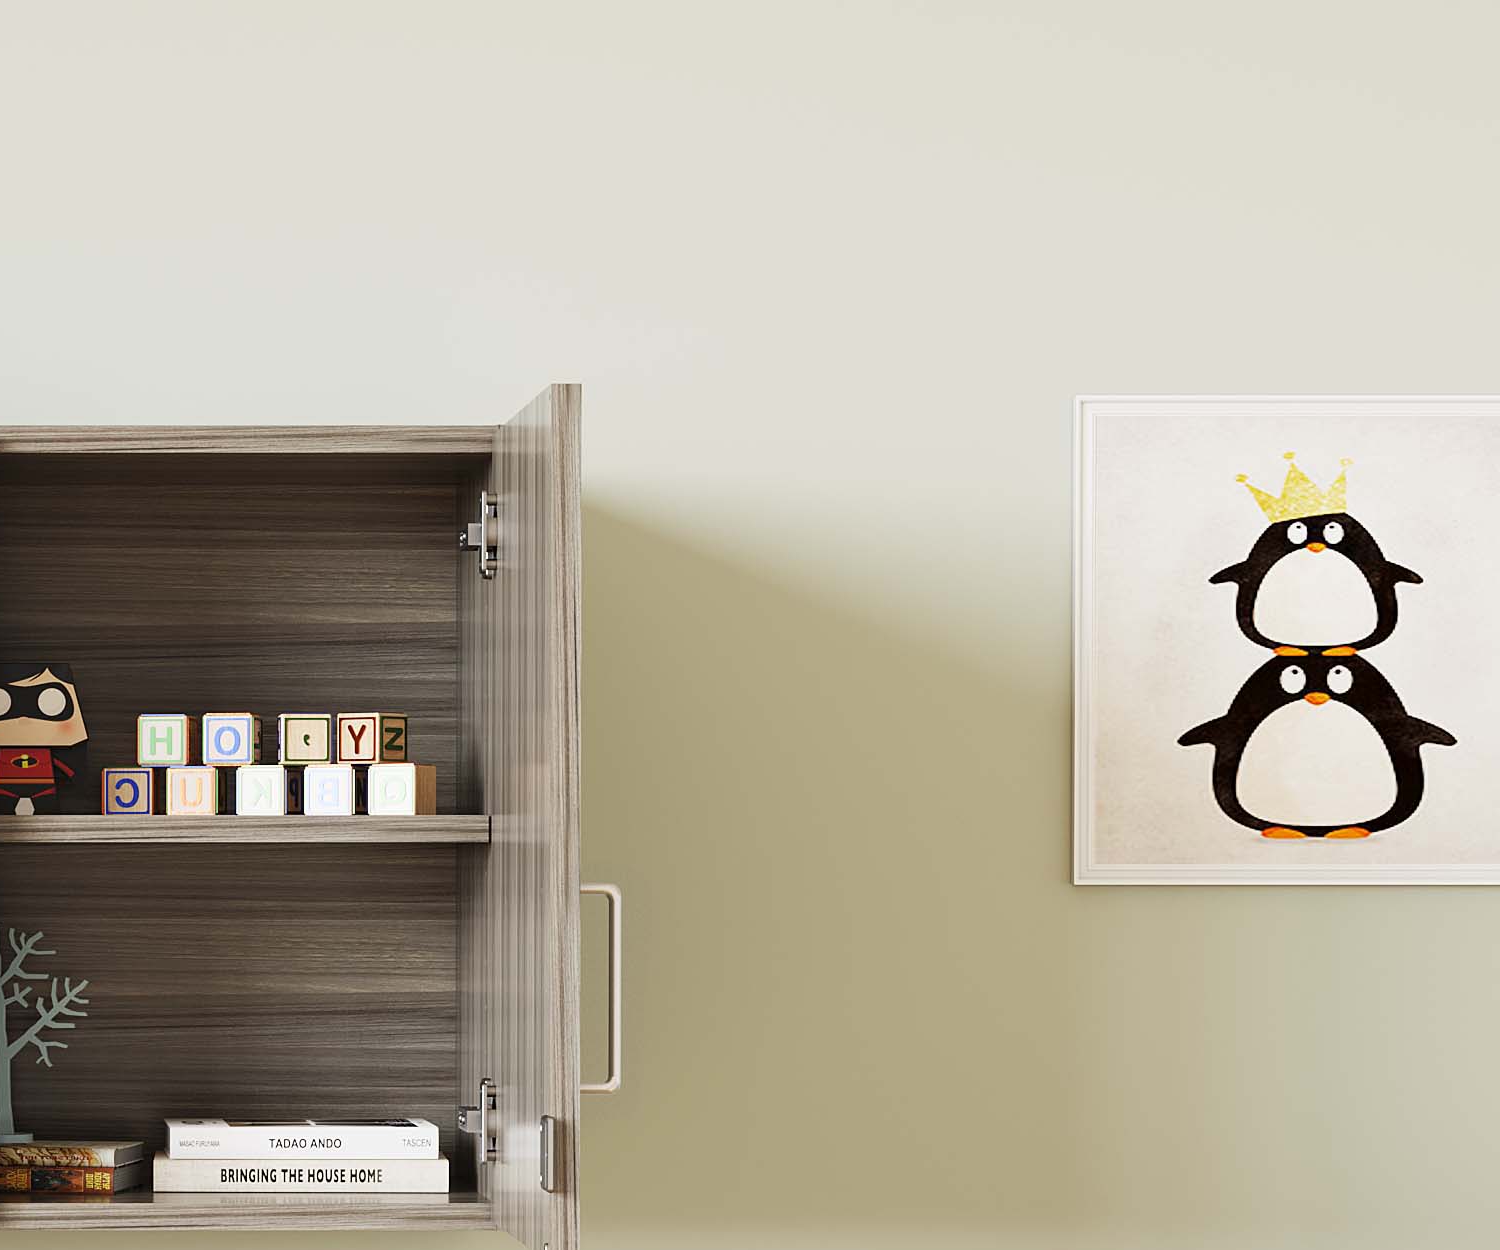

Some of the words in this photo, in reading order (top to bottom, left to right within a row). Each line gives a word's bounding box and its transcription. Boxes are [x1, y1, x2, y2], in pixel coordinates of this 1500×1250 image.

[148, 726, 174, 756] H
[213, 725, 242, 757] O
[347, 724, 367, 755] Y
[384, 727, 404, 751] Z
[179, 778, 203, 808] U
[268, 1138, 307, 1149] TADAO
[310, 1138, 342, 1149] ANDO
[220, 1168, 277, 1183] BRINGING
[281, 1168, 304, 1183] THE
[307, 1168, 346, 1183] HOUSE
[350, 1168, 383, 1183] HOME
